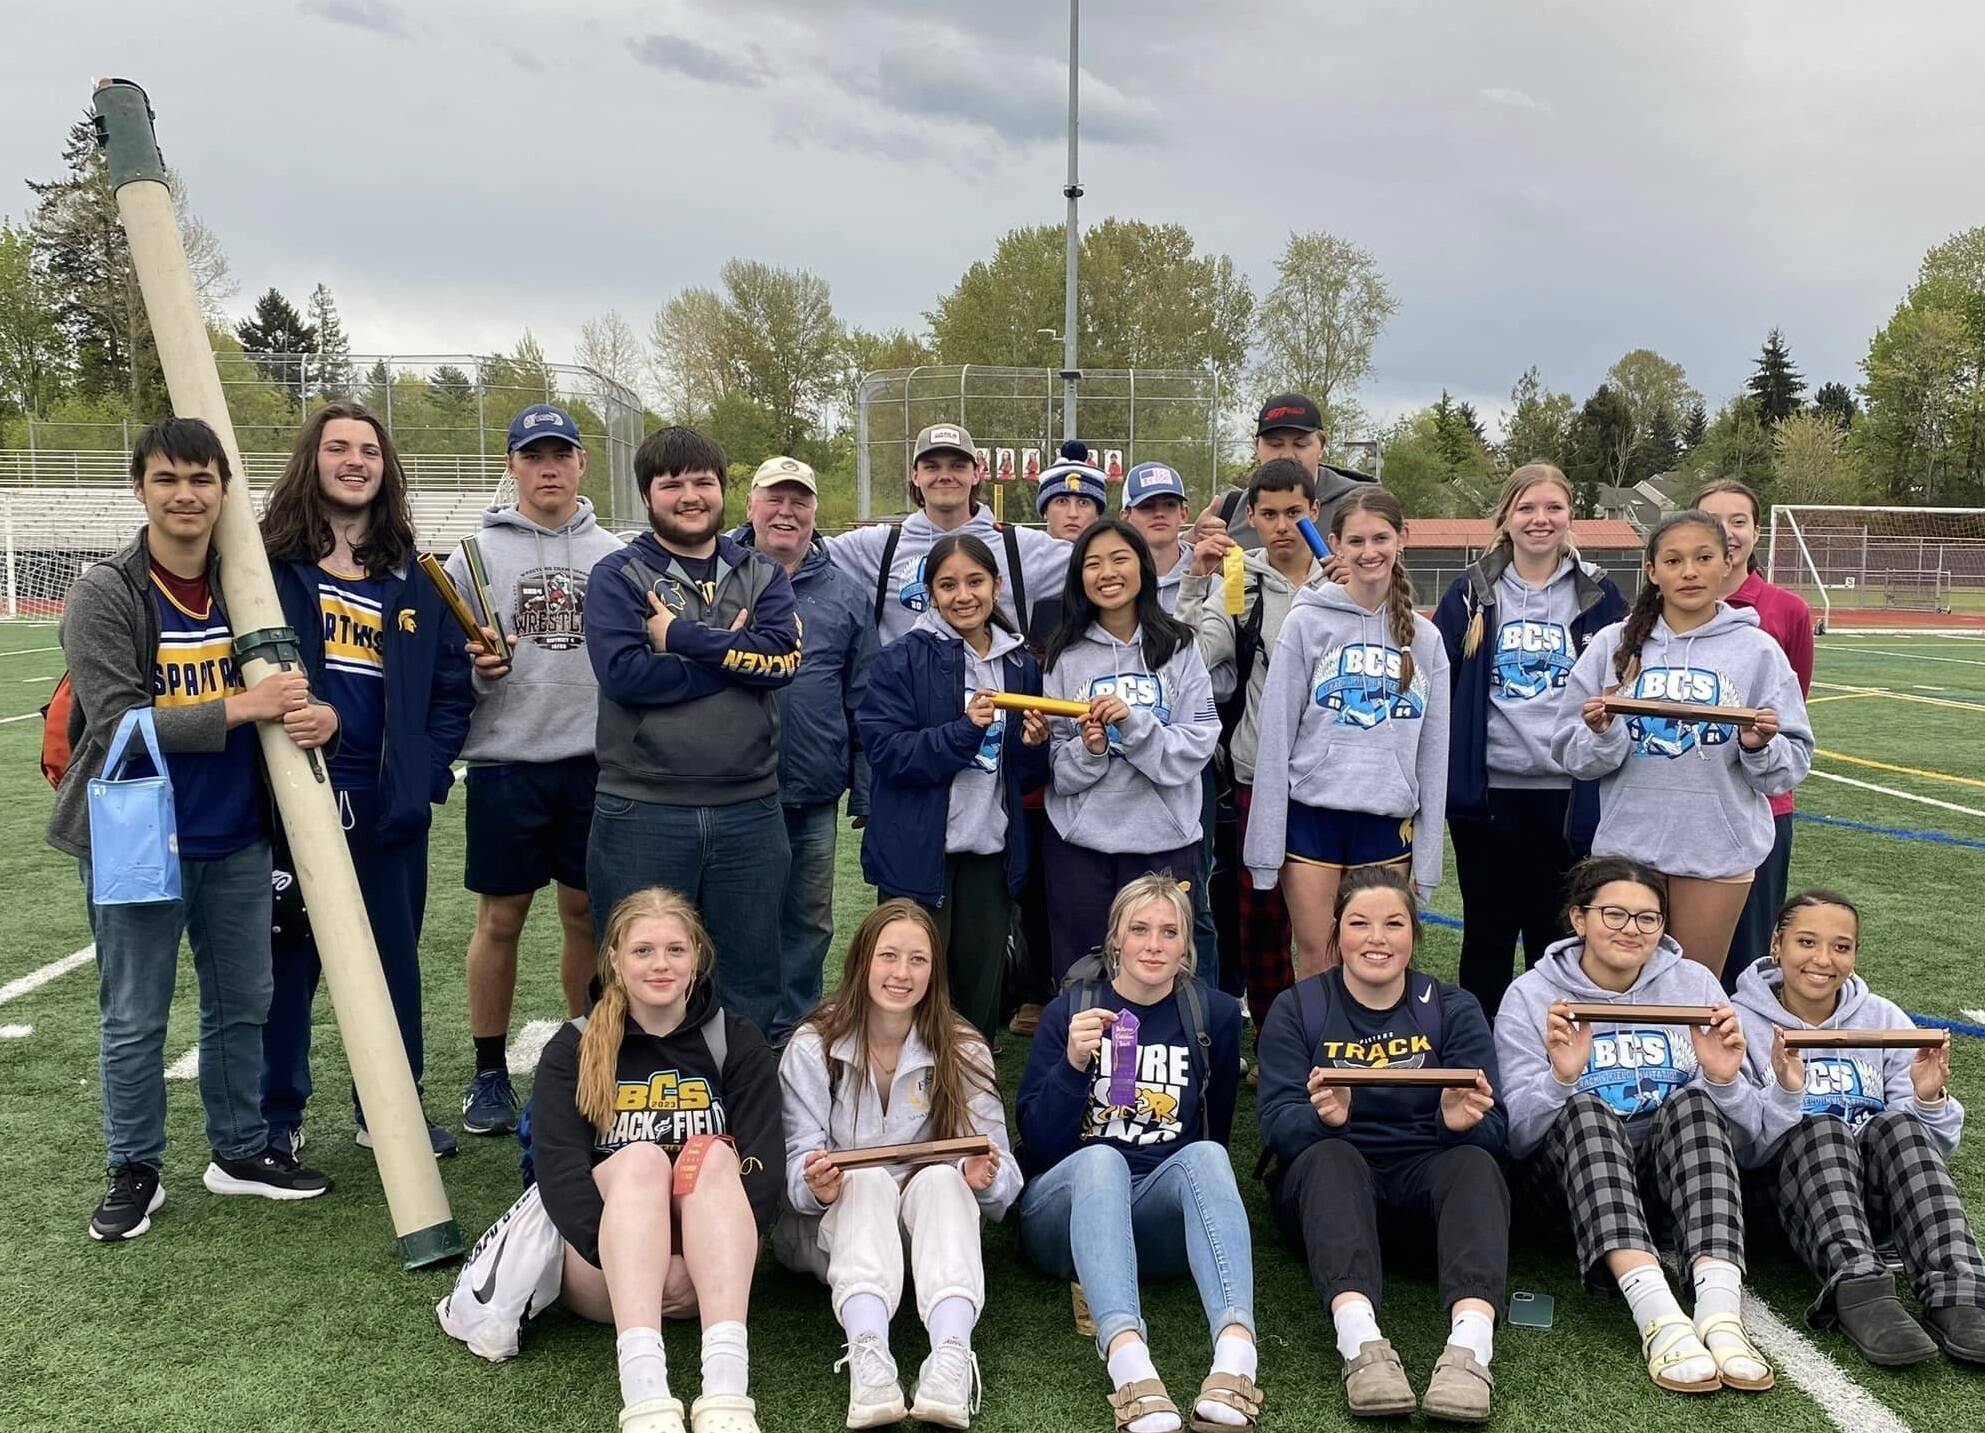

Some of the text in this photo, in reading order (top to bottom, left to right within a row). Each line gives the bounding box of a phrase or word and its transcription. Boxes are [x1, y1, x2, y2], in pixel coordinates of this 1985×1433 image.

[1502, 623, 1562, 653] BCS
[1345, 646, 1402, 679] BCS
[1641, 669, 1715, 701] BCS
[1323, 1034, 1432, 1062] TRACK
[1594, 1034, 1666, 1068] BCS
[615, 1070, 713, 1111] BCS
[651, 1101, 677, 1109] 2023
[600, 1111, 657, 1145] RACK
